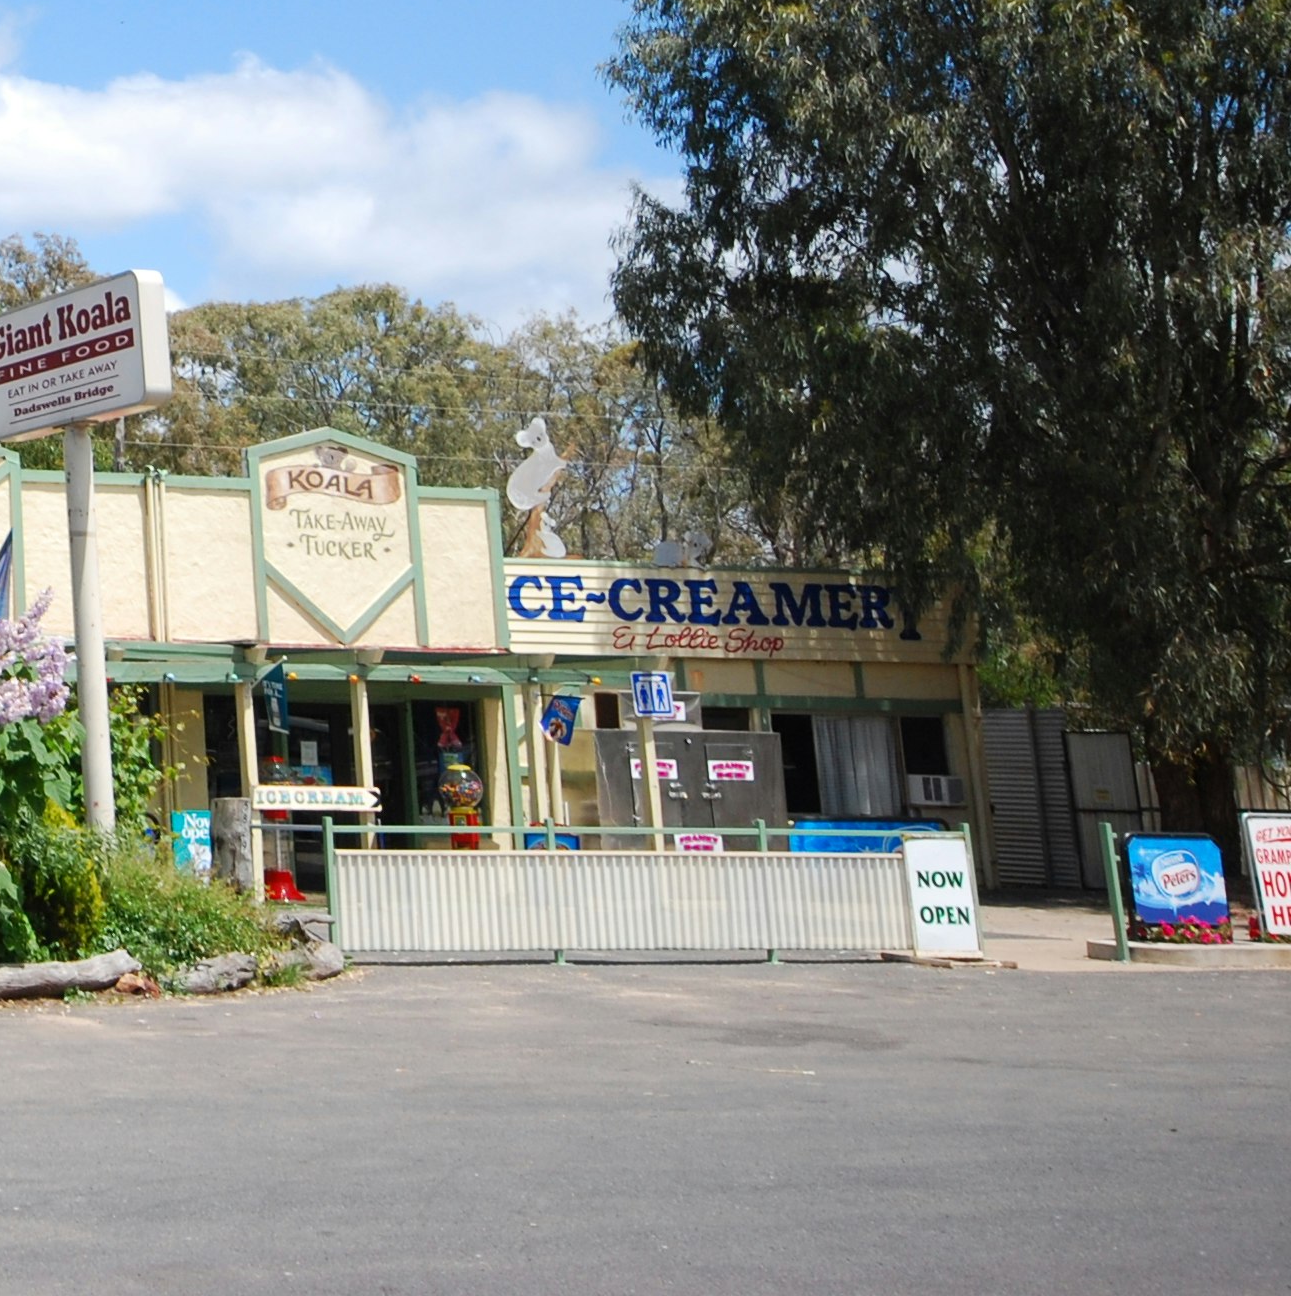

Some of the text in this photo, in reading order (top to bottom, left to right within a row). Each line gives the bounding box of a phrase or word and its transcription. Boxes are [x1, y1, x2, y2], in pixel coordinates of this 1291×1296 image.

[56, 291, 131, 341] Koala
[61, 335, 129, 363] FOOD
[7, 360, 118, 399] EAT IN OR TAKE AWAY
[13, 384, 114, 417] Dadswells Bridge
[287, 470, 374, 500] KOALA
[289, 508, 396, 542] TAKE-AWAY
[299, 533, 377, 561] TUCKER
[645, 626, 719, 651] Lollie
[724, 628, 785, 657] Shop
[916, 870, 964, 889] NOW
[1161, 868, 1197, 890] Peters
[920, 906, 971, 925] OPEN
